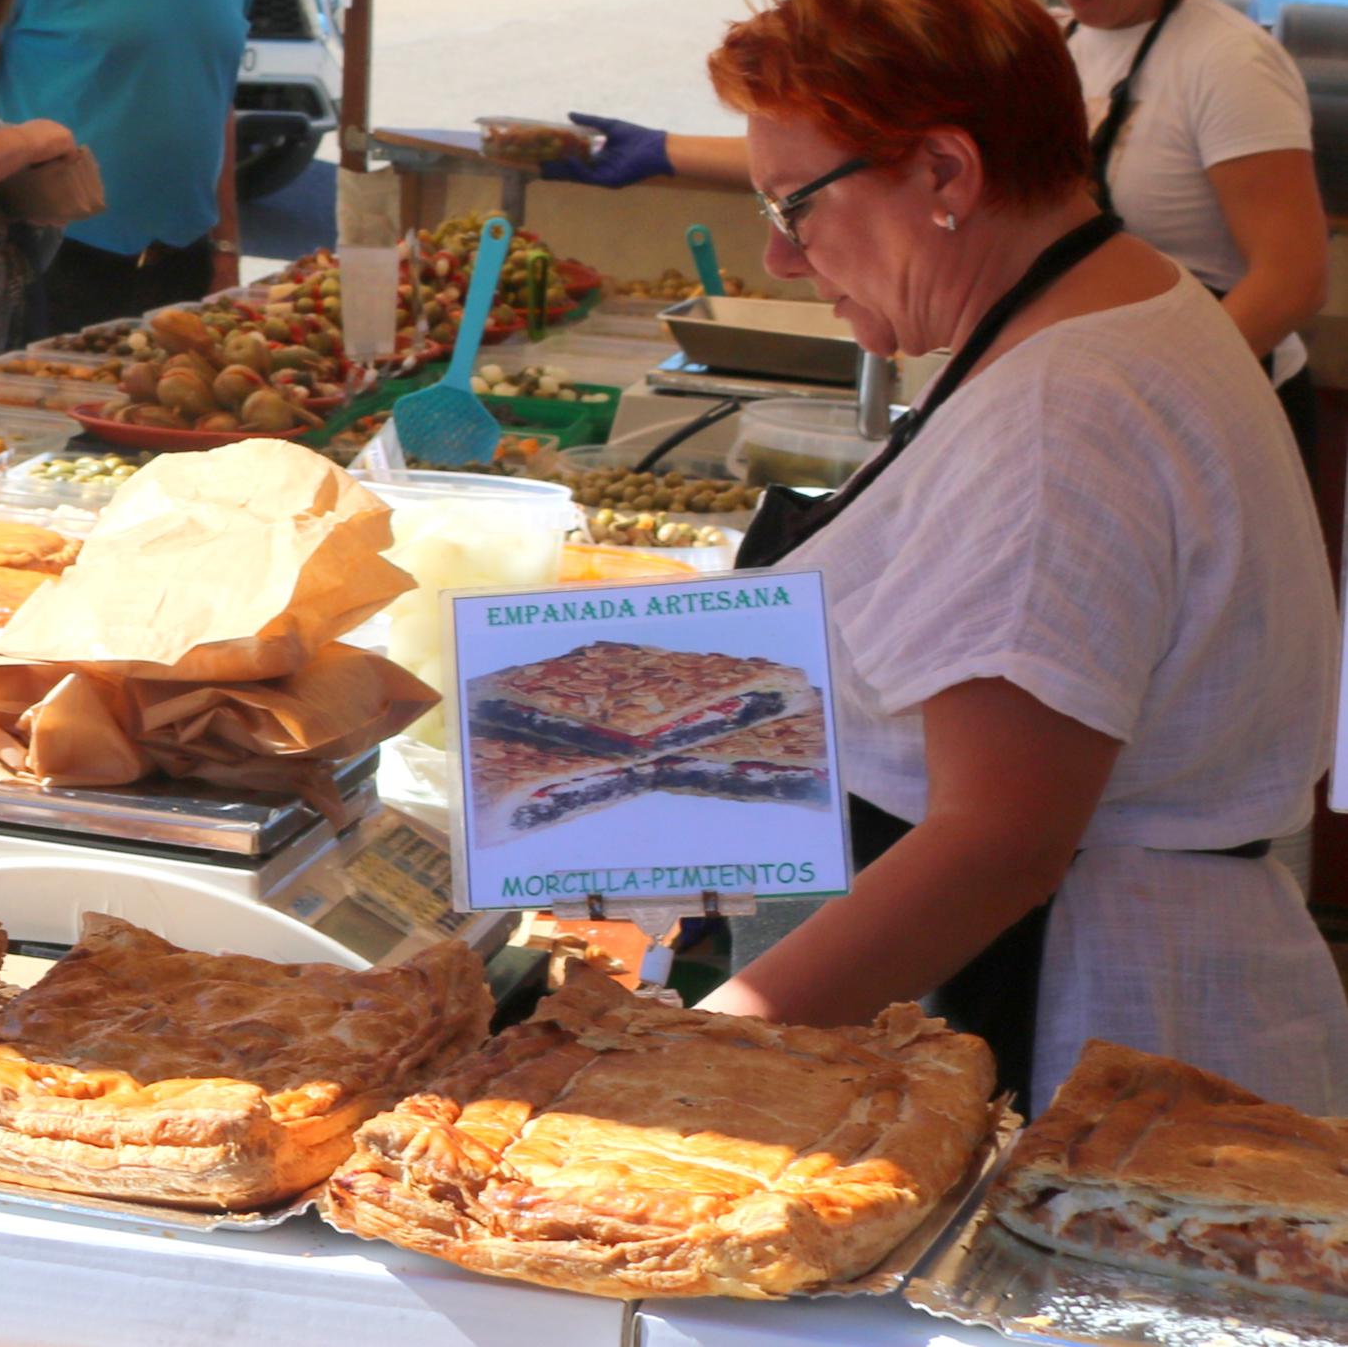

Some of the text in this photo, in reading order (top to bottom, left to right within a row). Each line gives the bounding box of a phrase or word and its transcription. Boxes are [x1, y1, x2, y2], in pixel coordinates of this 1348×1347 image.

[486, 584, 792, 628] EMPANADA ARTESANA
[501, 860, 817, 898] MORCILLA-PIMIENTOS
